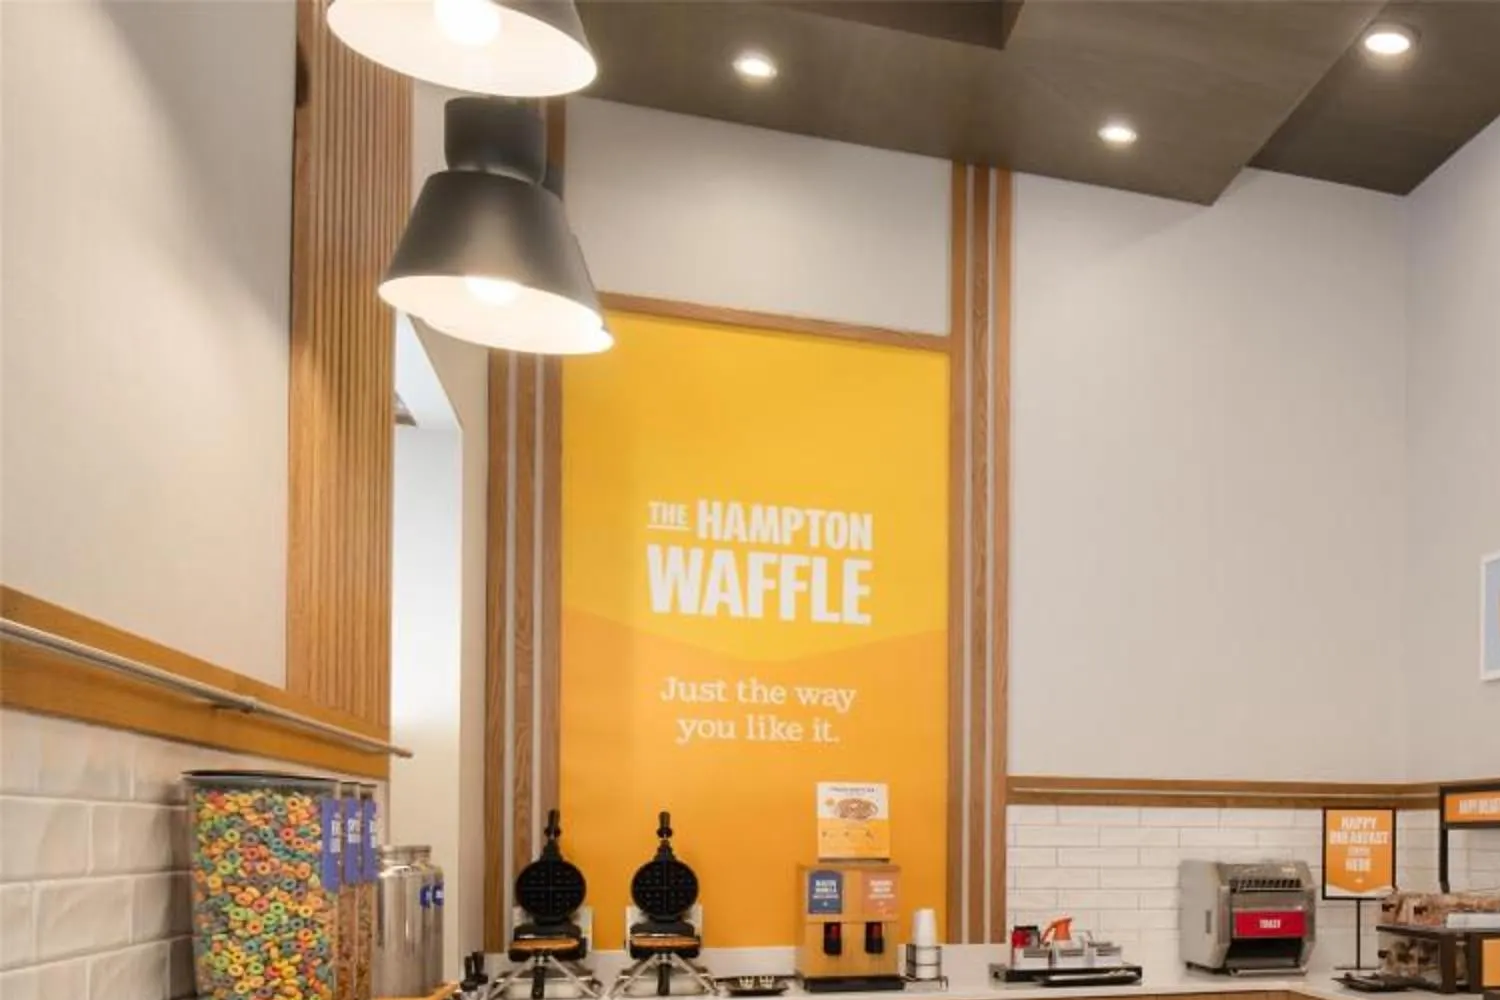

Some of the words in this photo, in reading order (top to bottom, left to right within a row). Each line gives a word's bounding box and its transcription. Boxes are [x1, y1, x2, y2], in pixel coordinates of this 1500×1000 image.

[648, 501, 688, 526] THE
[696, 499, 873, 551] HAMPTON
[646, 543, 873, 625] WAFFLE
[661, 676, 727, 702] Just
[737, 678, 786, 704] the
[795, 686, 857, 713] way
[675, 717, 736, 745] you
[746, 714, 803, 741] like
[812, 717, 840, 743] it.
